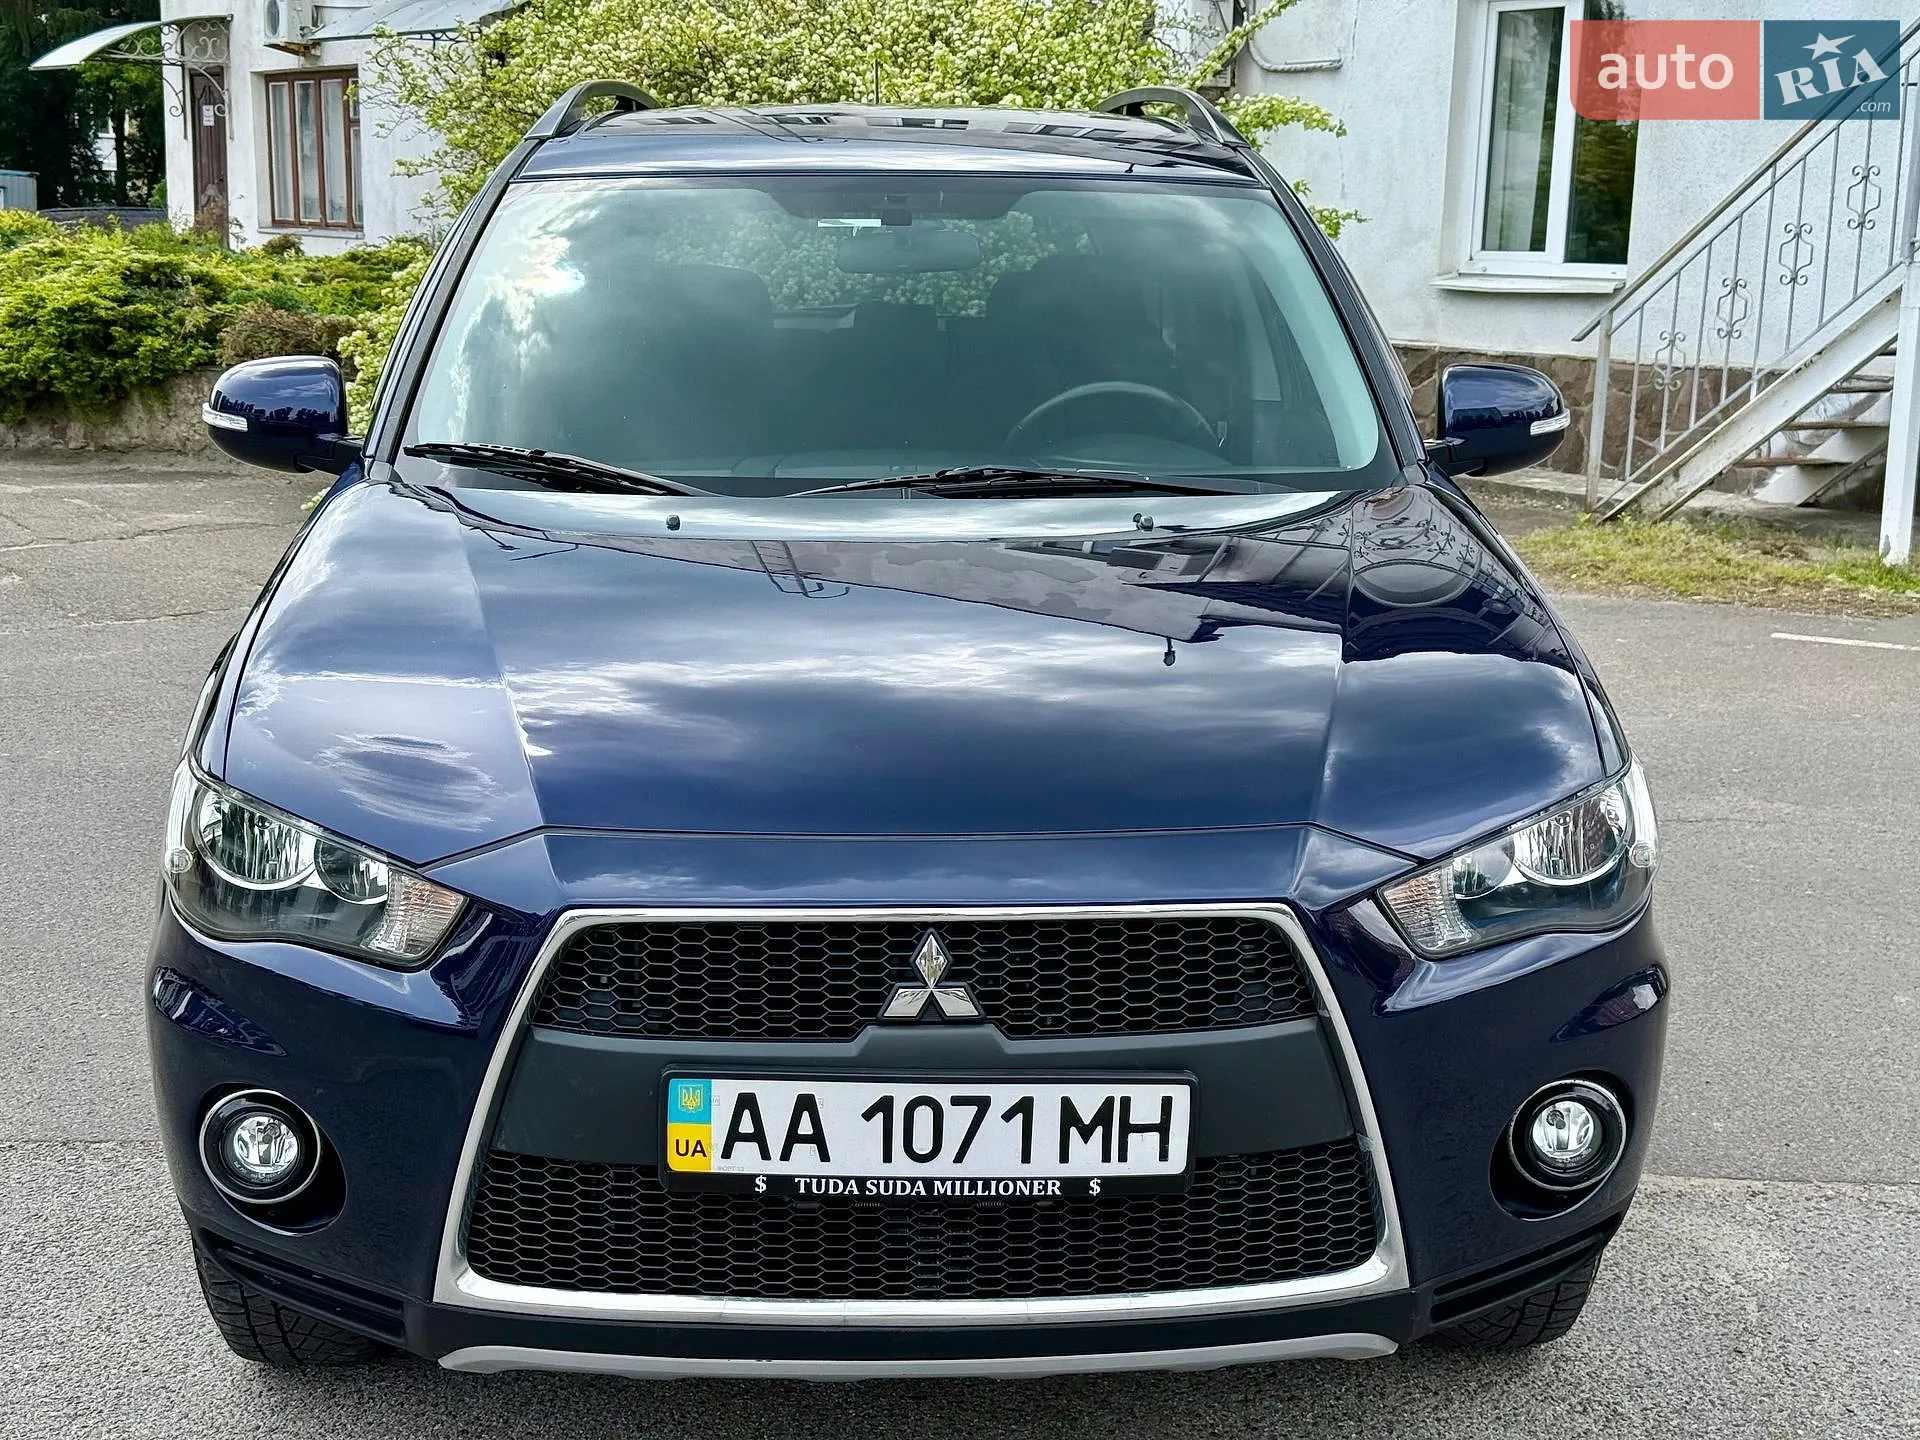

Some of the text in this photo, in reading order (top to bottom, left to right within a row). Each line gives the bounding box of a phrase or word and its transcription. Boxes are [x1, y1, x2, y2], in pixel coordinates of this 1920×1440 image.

[720, 1092, 1173, 1165] AA 1071 MH
[675, 1138, 708, 1158] UA
[754, 1174, 1102, 1197] $ TUDA SUDA MILLIONER $
